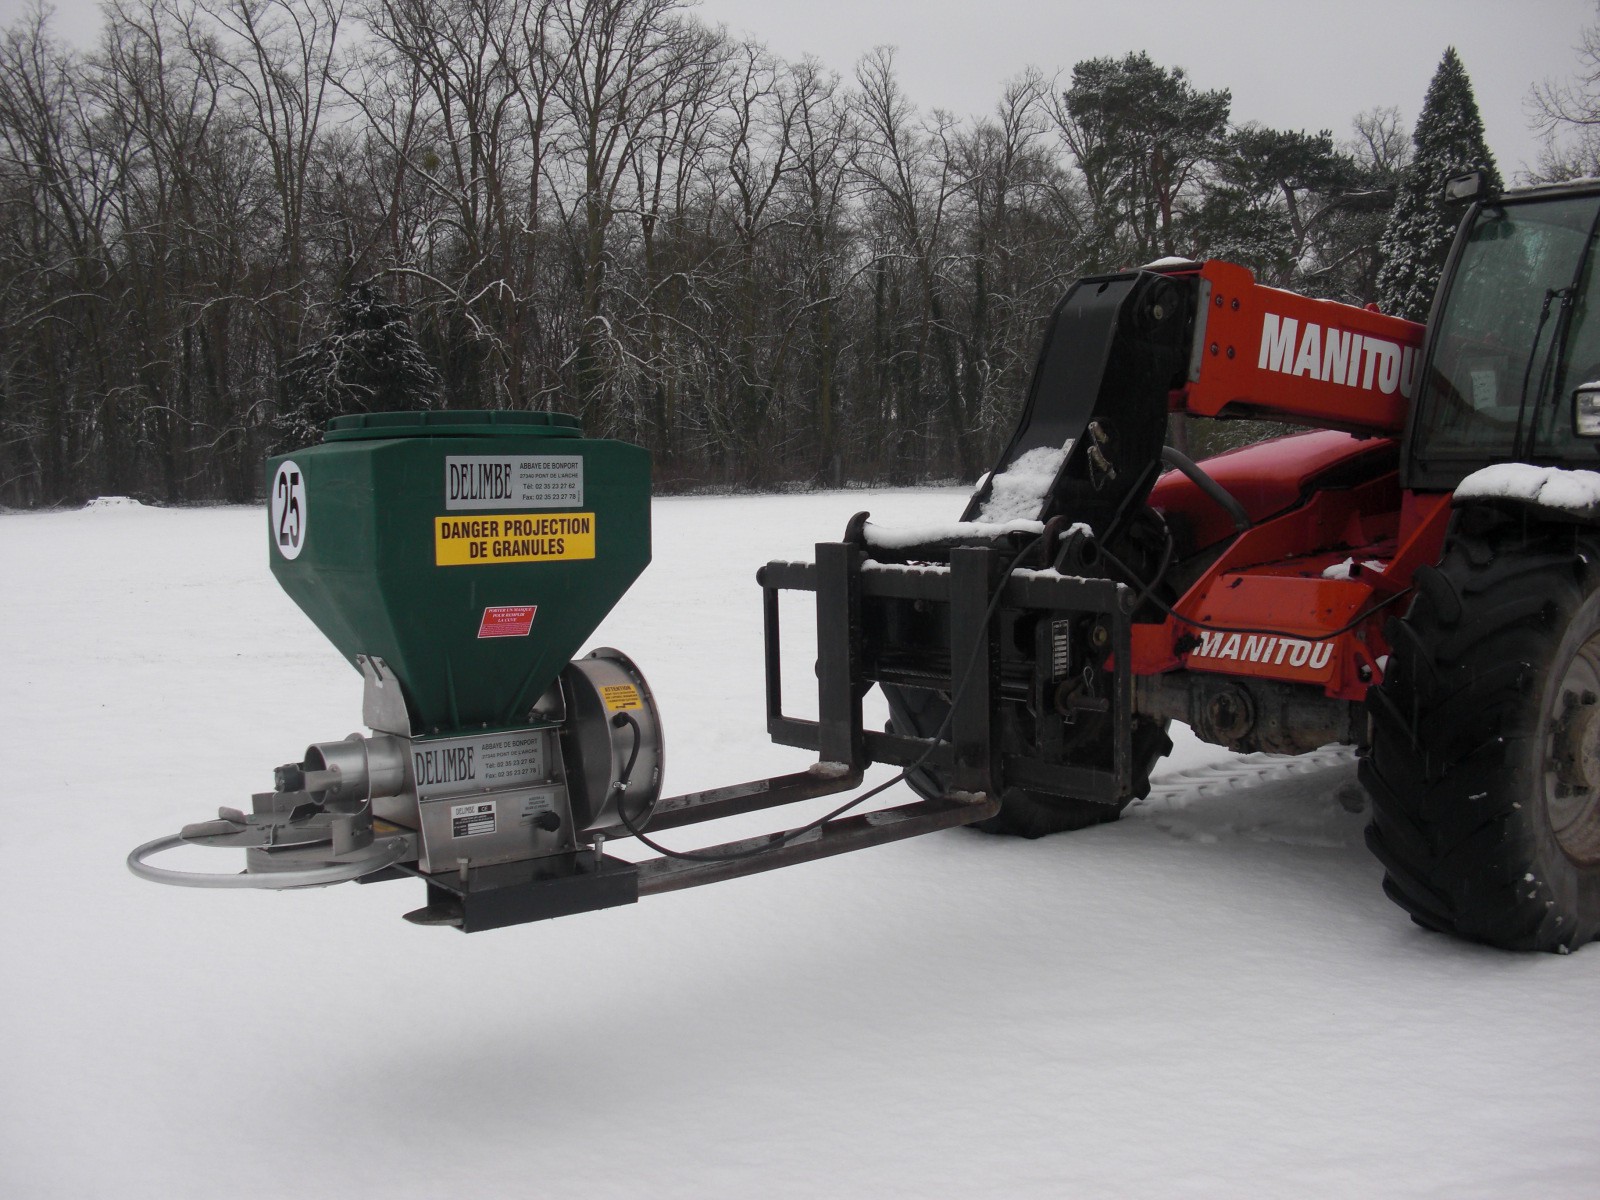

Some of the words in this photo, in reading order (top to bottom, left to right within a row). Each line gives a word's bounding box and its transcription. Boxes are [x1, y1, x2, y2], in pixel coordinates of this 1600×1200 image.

[1258, 312, 1421, 398] MANITOU
[450, 464, 512, 500] DELIMBE
[278, 471, 300, 548] 25
[442, 520, 499, 540] DANGER
[504, 518, 590, 536] PROJECTION
[470, 542, 488, 558] DE
[492, 538, 564, 558] GRANULES
[1192, 631, 1334, 669] MANITOU
[482, 742, 502, 750] ABBAYE
[415, 747, 475, 786] DELIMBE
